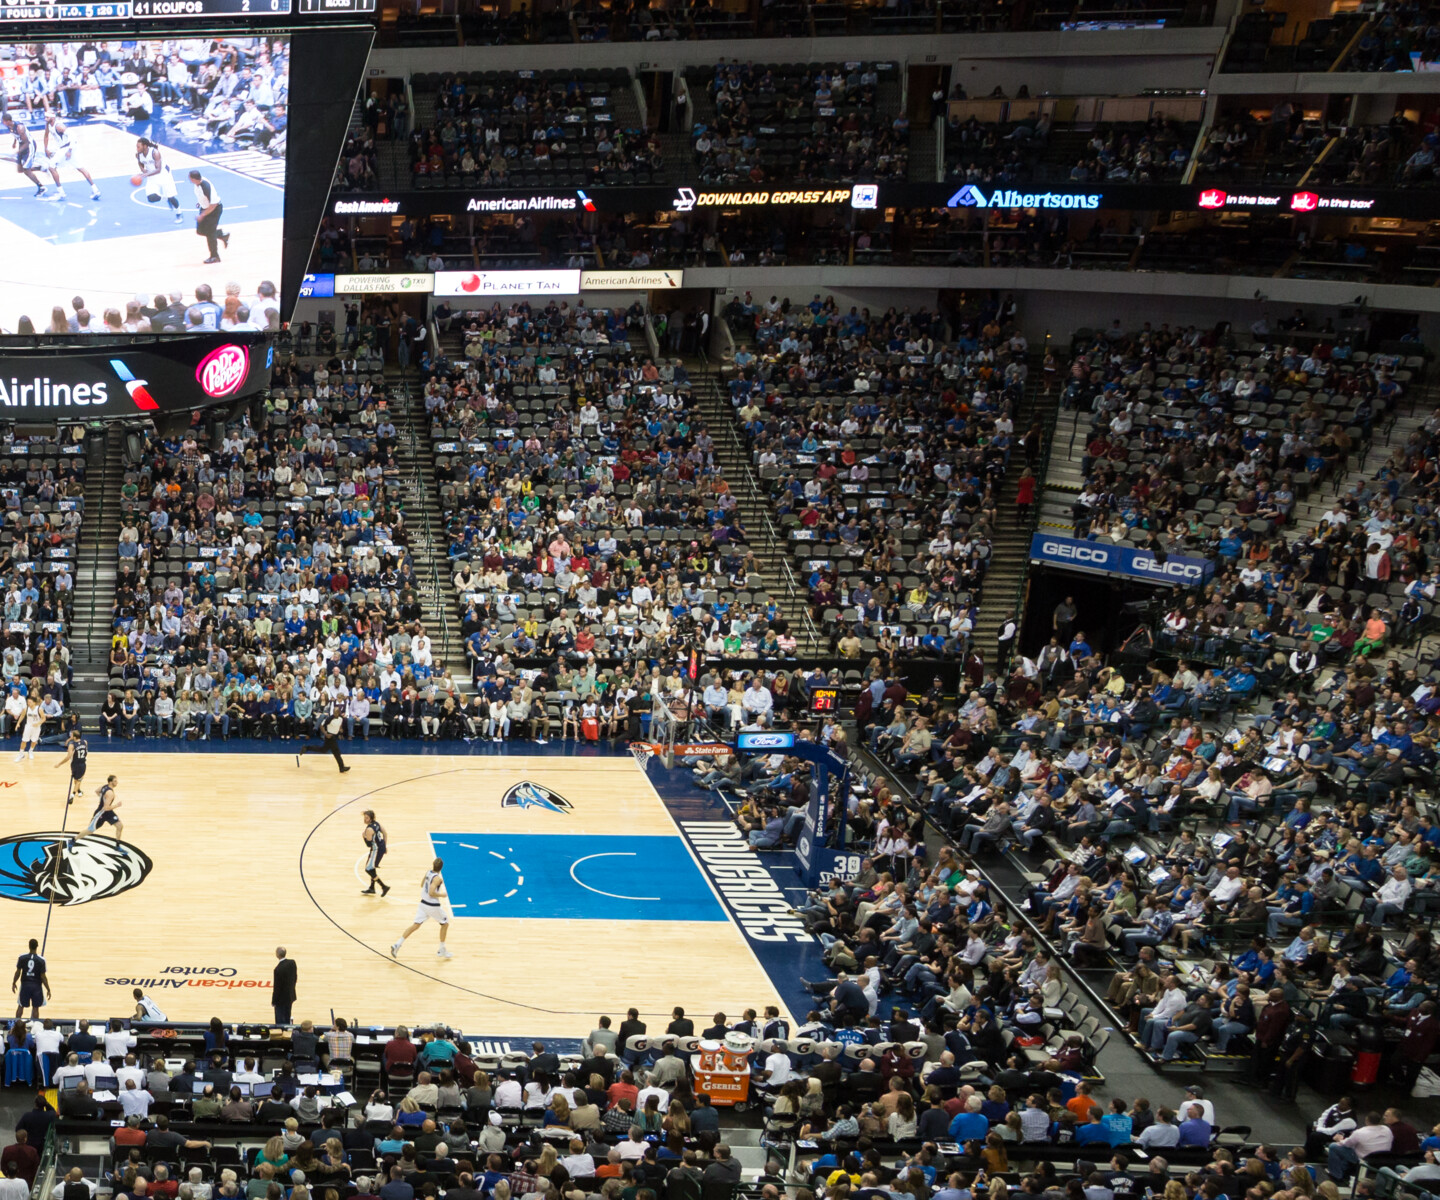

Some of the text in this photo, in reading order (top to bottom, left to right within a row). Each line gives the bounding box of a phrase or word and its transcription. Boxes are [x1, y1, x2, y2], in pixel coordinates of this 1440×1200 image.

[6, 8, 42, 19] FOULS
[45, 6, 54, 19] 0
[61, 7, 81, 17] T.O.
[85, 6, 93, 17] 5
[116, 5, 125, 16] 0
[135, 4, 151, 14] 41
[153, 3, 203, 14] KOUFOS
[242, 1, 250, 11] 2
[467, 197, 576, 211] American Airlines
[697, 190, 850, 206] DOWNLOAD GOPASS APP
[988, 190, 1100, 209] Albertsons
[1238, 195, 1256, 204] the
[1258, 196, 1277, 205] box
[1330, 198, 1349, 208] the
[1350, 199, 1371, 209] box
[349, 276, 390, 284] POWERING
[483, 280, 561, 290] PLANET TAN
[585, 275, 662, 286] American Airlines
[344, 283, 395, 292] DALLAS FANS
[219, 352, 235, 371] Dr
[208, 358, 242, 393] Pepper
[1042, 541, 1109, 564] GEICO
[1132, 556, 1203, 579] GEICO
[815, 690, 837, 698] 10:44
[815, 697, 831, 710] 21
[754, 736, 778, 745] Ford
[77, 750, 85, 759] 12
[834, 856, 860, 874] 30
[679, 820, 816, 943] MAVERICKS
[27, 960, 35, 973] 9
[160, 966, 237, 978] Center
[104, 977, 274, 990] mericanAirlines
[838, 1034, 860, 1043] DALLAS
[702, 1081, 742, 1091] G SERIES
